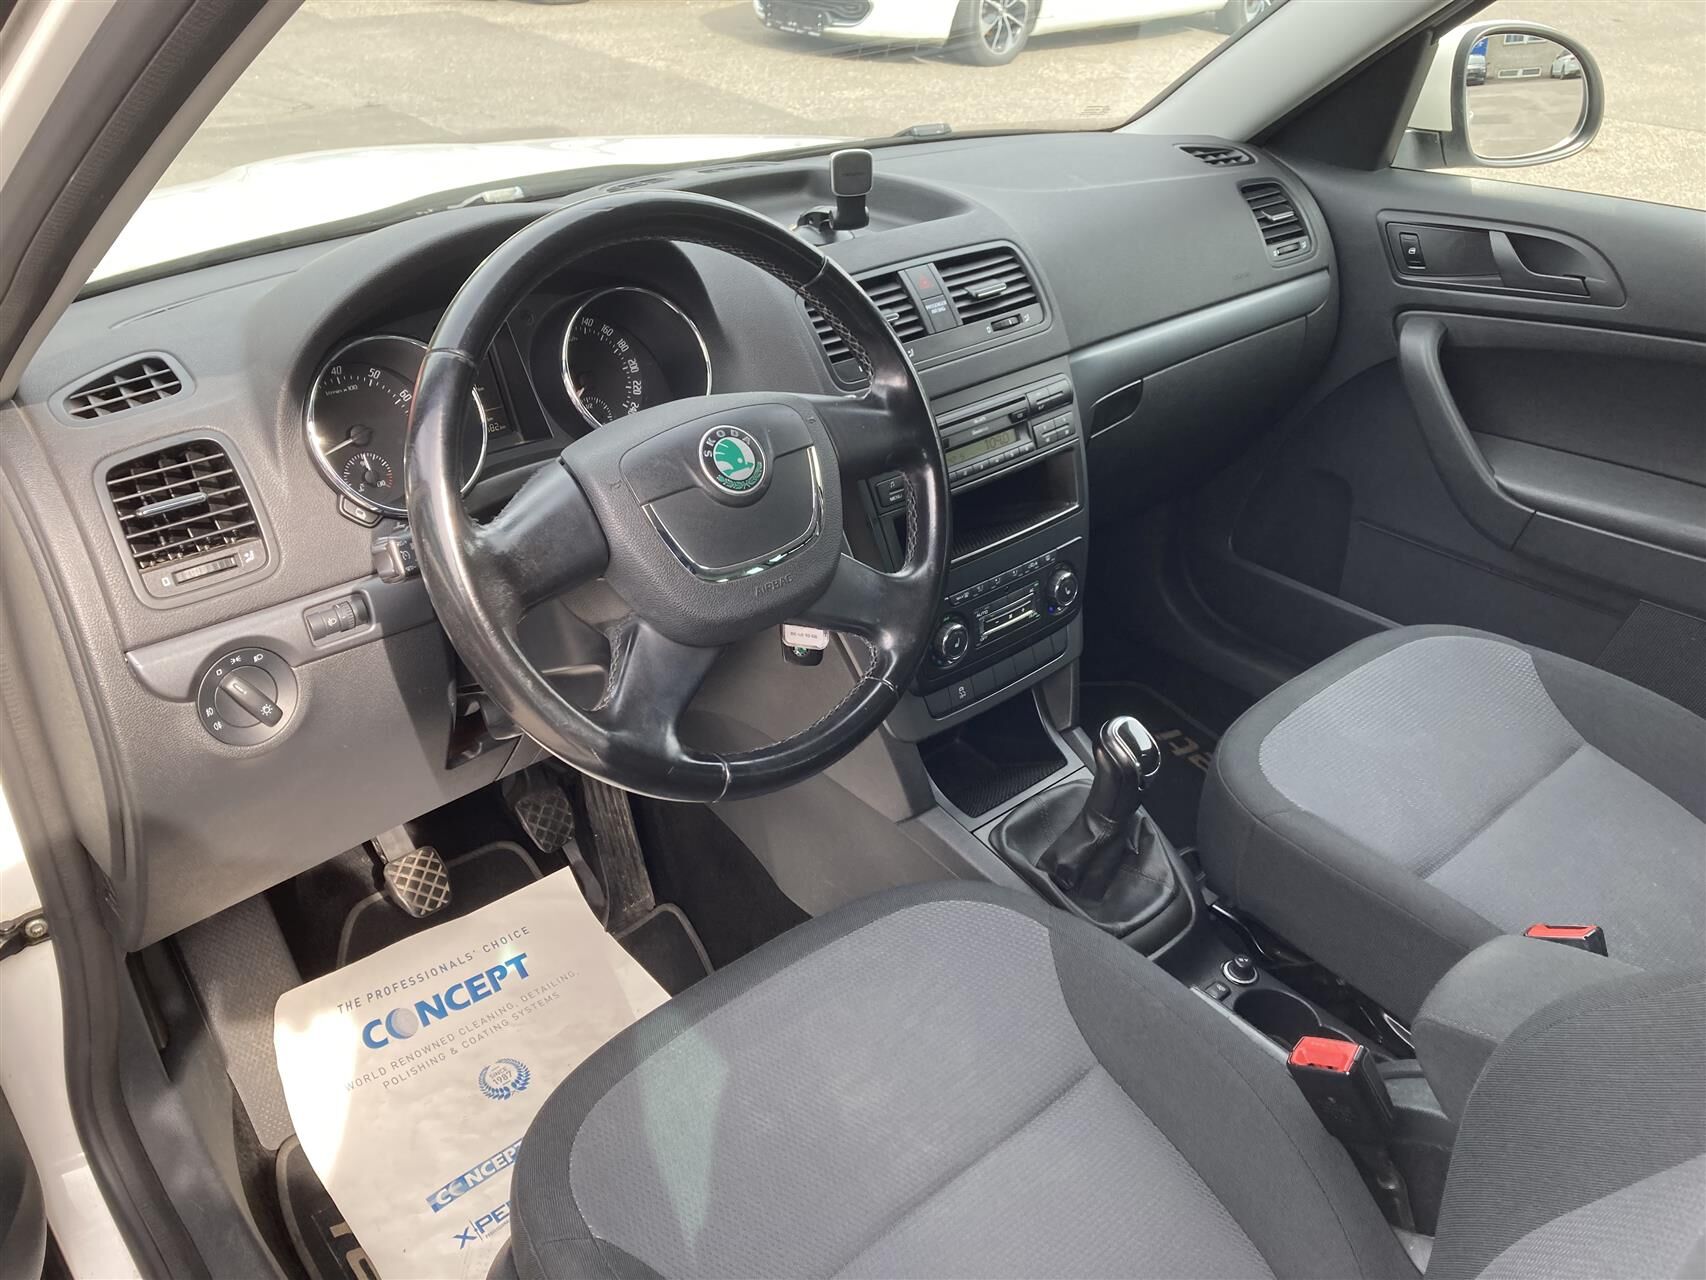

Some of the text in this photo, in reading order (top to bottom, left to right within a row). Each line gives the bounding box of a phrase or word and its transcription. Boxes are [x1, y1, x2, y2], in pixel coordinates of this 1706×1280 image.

[581, 317, 594, 327] 140
[600, 324, 614, 337] 160
[616, 338, 630, 353] 180
[331, 365, 342, 376] 40
[627, 358, 640, 373] 200
[367, 367, 381, 380] 50
[632, 380, 642, 395] 220
[399, 389, 412, 402] 60
[337, 997, 362, 1014] THE
[482, 926, 530, 953] CHOICE
[362, 952, 531, 1049] CONCEPT
[382, 992, 560, 1089] POLISHING & COATING SYSTEMS
[345, 1066, 387, 1091] WORLD
[390, 1033, 455, 1071] RENOWNED
[492, 1070, 513, 1085] 1987
